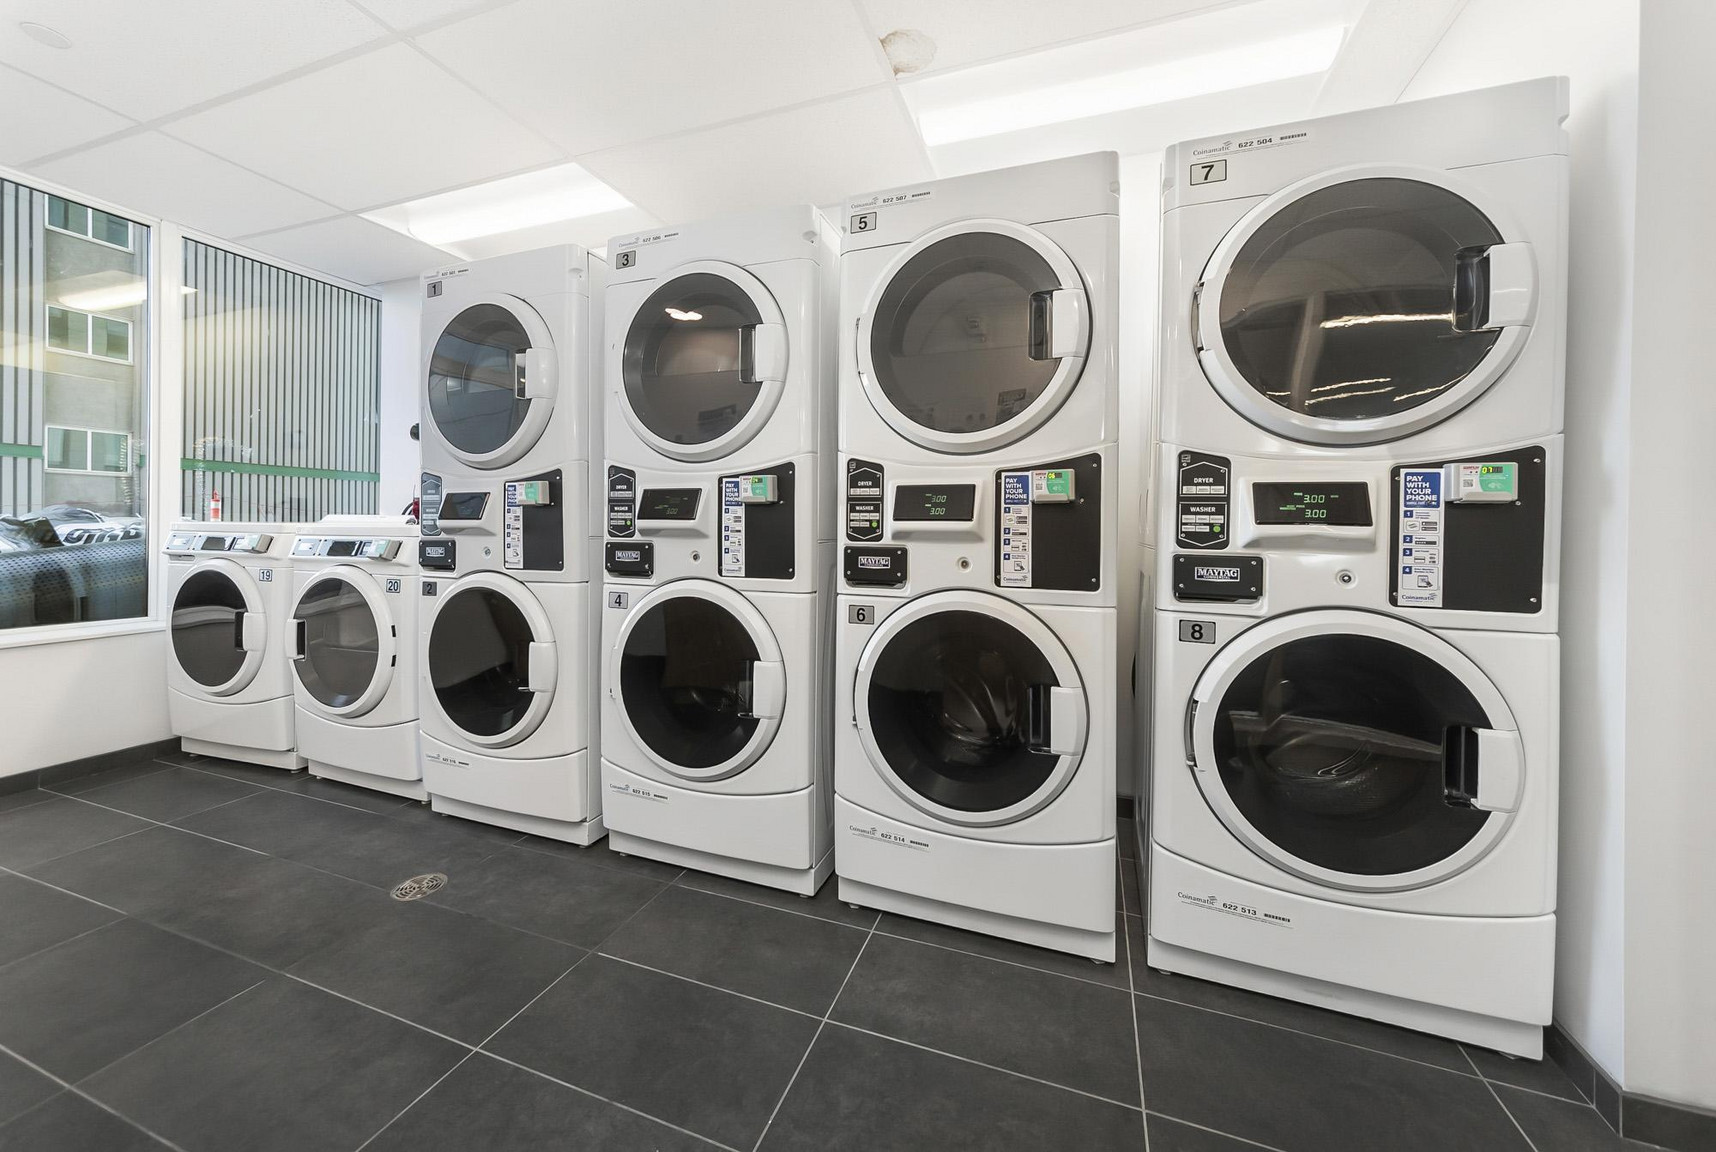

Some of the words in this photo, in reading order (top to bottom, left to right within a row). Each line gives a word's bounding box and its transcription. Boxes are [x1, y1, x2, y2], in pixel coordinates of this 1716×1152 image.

[1192, 144, 1231, 156] Coinamatic
[1238, 140, 1254, 148] 622
[1256, 138, 1273, 146] 504
[1201, 164, 1215, 180] 7
[858, 216, 868, 230] 5
[622, 254, 630, 266] 3
[432, 284, 436, 295] 1
[1304, 494, 1325, 503] 3.00
[1305, 510, 1326, 518] 3.00
[261, 570, 271, 580] 19
[1197, 568, 1237, 577] MAYTAG
[388, 581, 399, 592] 20
[427, 584, 432, 594] 2
[615, 594, 622, 607] 4
[857, 608, 866, 622] 6
[1191, 623, 1203, 640] 8
[1178, 892, 1216, 906] Coinamatic
[1222, 902, 1238, 912] 622
[1241, 907, 1257, 916] 513
